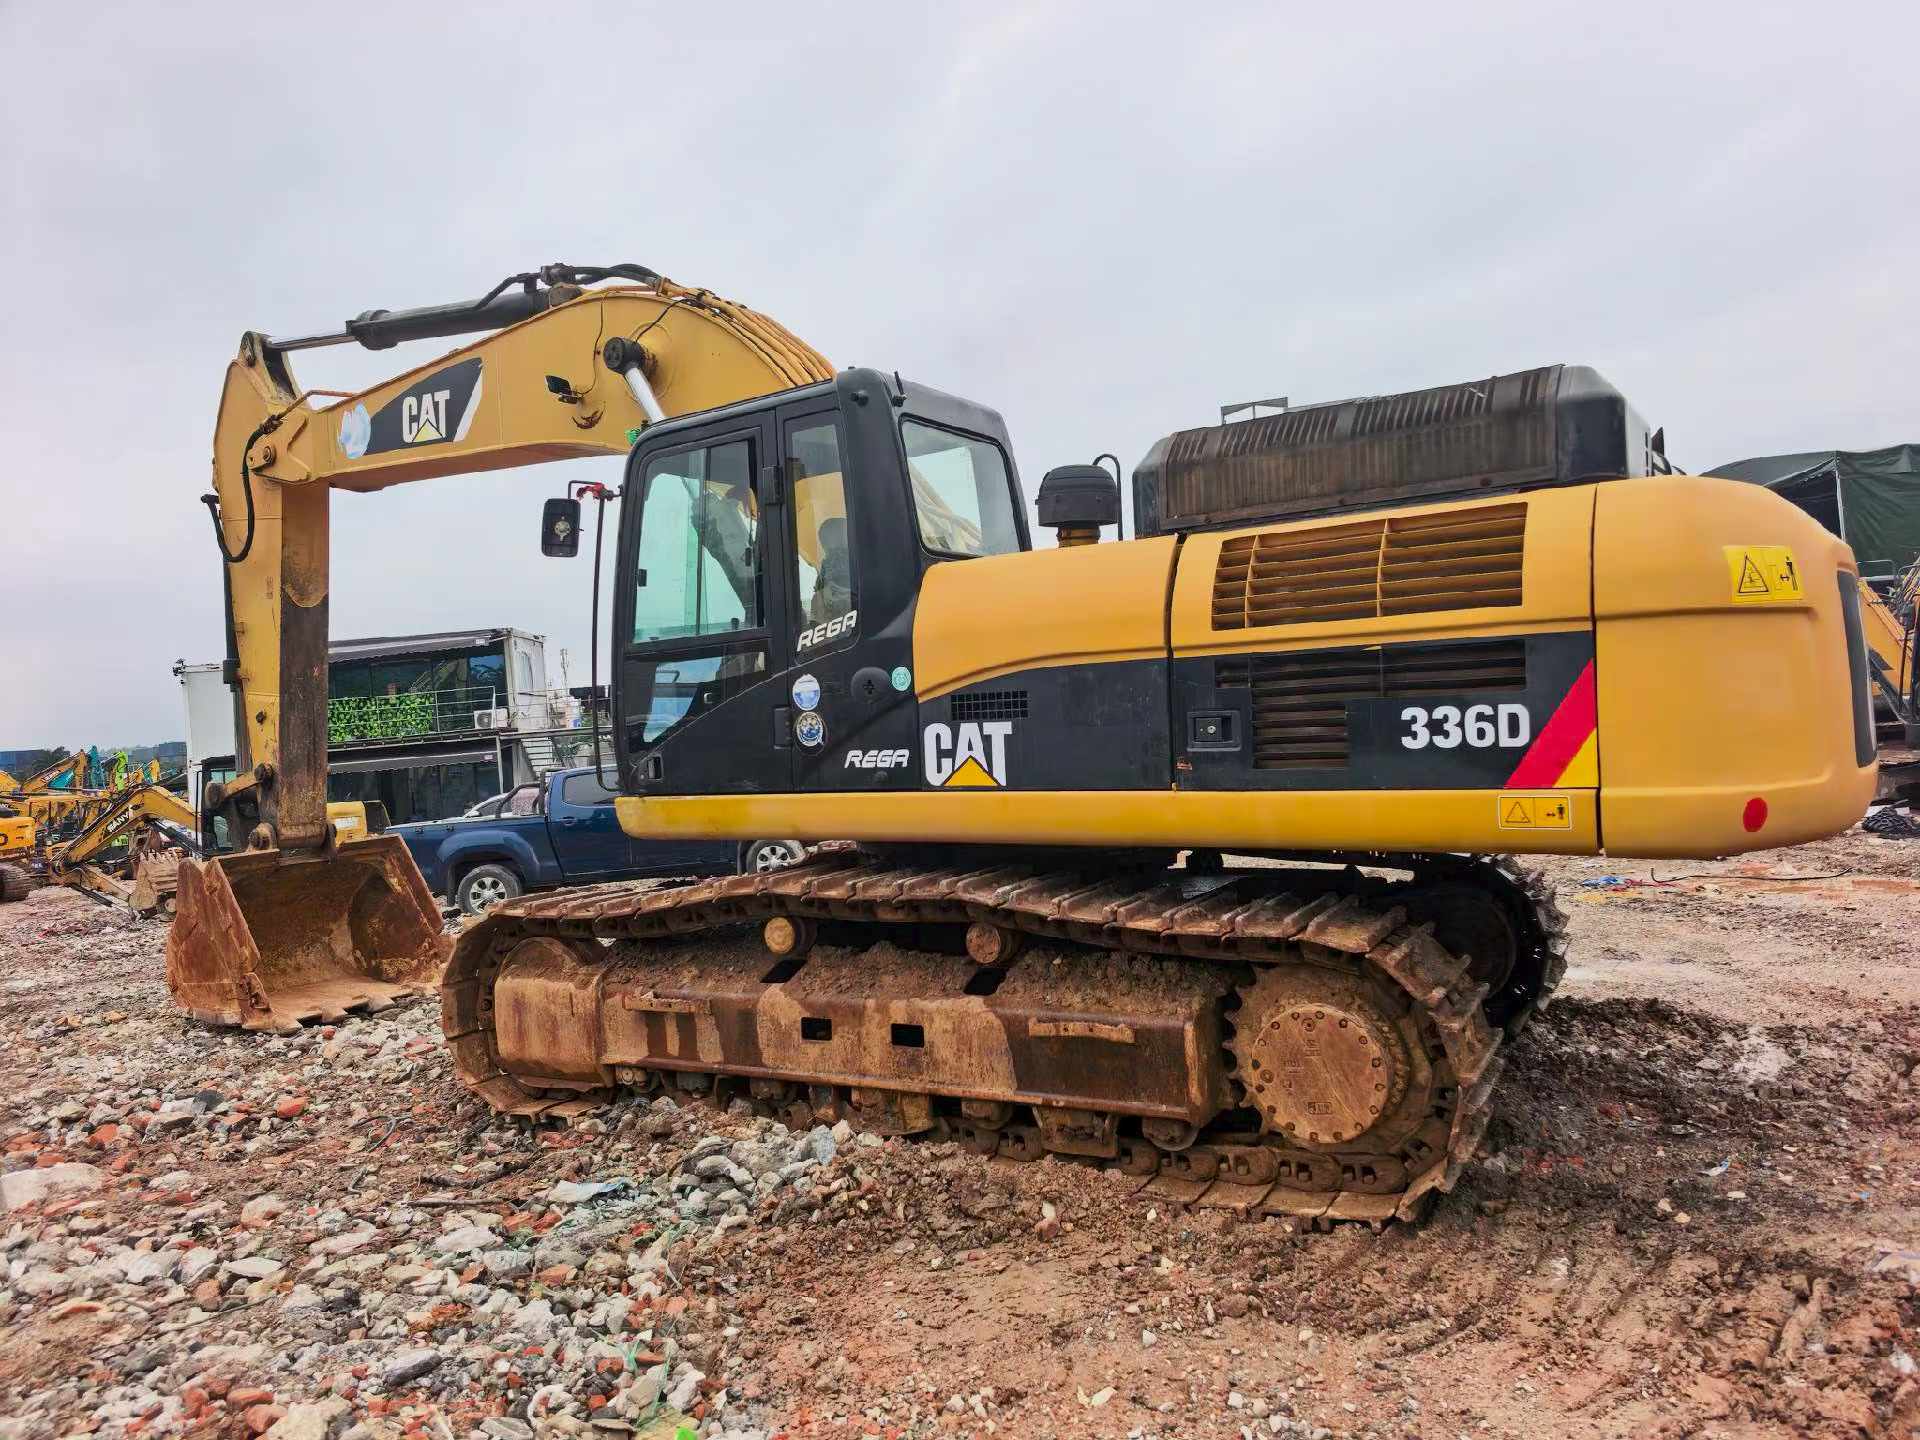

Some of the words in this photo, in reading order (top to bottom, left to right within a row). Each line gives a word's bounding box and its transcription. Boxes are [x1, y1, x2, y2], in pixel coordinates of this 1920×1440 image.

[402, 389, 450, 443] CAT
[796, 609, 858, 652] REGA
[1400, 703, 1531, 749] 336D
[844, 748, 910, 769] REGA
[923, 721, 1013, 787] CAT
